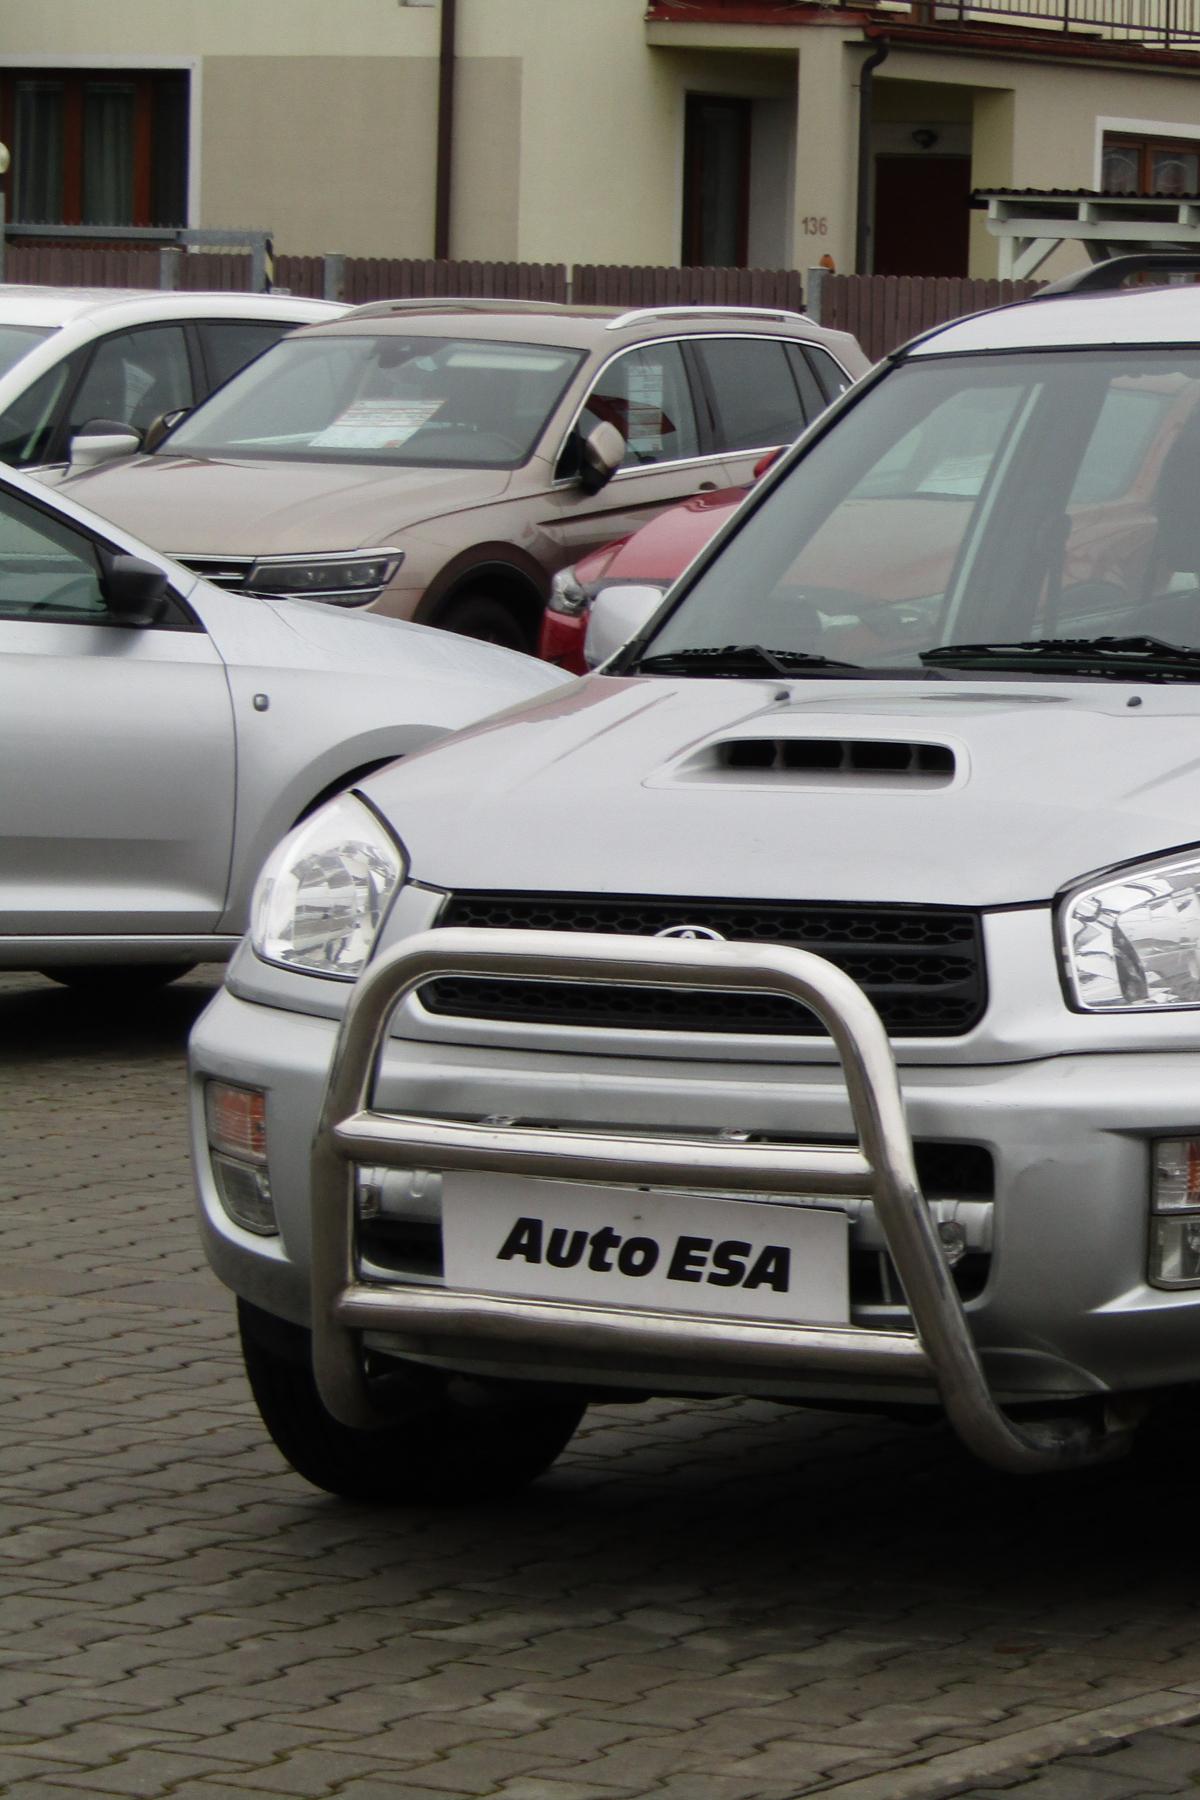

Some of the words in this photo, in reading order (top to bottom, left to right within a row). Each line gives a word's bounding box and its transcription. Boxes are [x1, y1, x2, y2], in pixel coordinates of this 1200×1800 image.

[801, 216, 828, 236] 136
[496, 1216, 660, 1278] Auto
[667, 1234, 792, 1293] ESA
